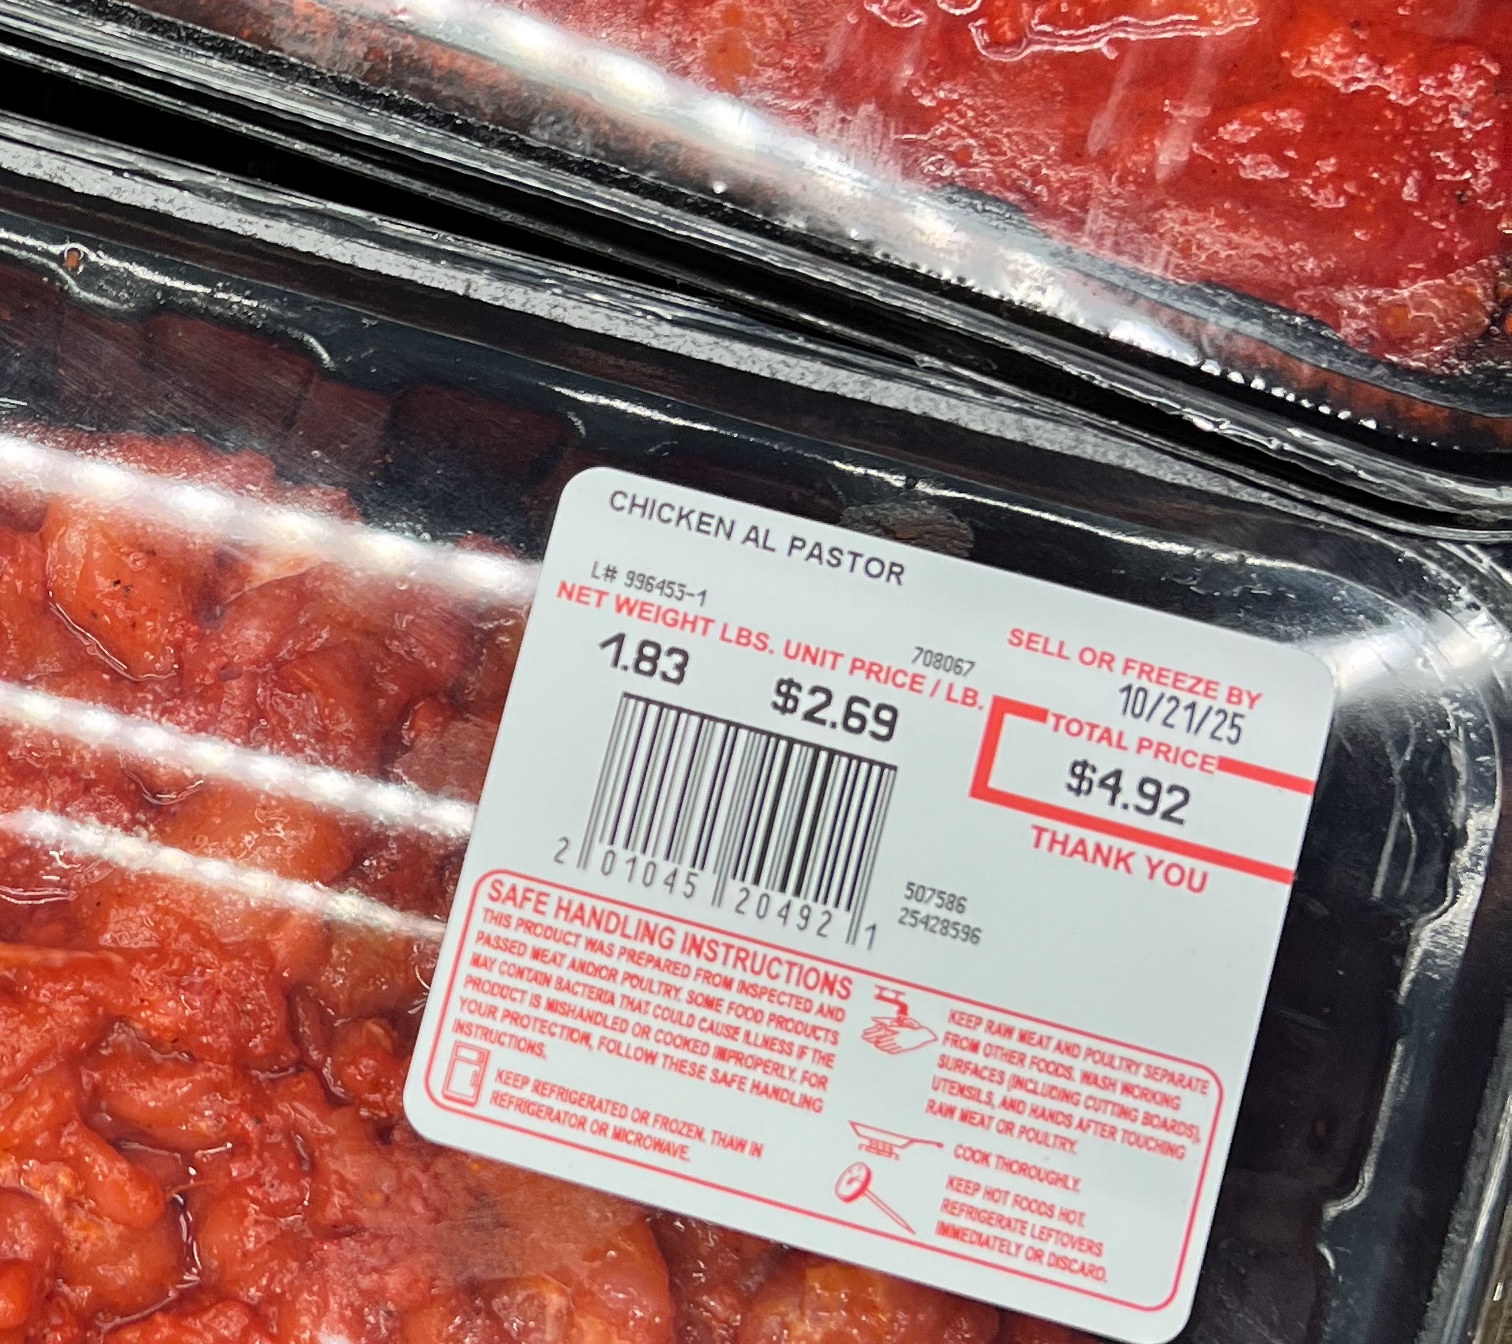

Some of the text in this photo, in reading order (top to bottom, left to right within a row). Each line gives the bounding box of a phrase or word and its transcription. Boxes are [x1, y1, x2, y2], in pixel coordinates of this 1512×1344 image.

[609, 489, 905, 586] CHICKEN AL PASTOR
[556, 580, 609, 608] NET
[614, 594, 715, 636] WEIGHT
[719, 622, 774, 654] LBS.
[782, 638, 844, 671] UNIT
[848, 656, 926, 694] PRICE
[944, 682, 983, 710] LB.
[599, 632, 689, 685] 1.83
[911, 645, 975, 677] 708067
[1007, 627, 1262, 710] SELL OR FREEZE BY
[770, 677, 898, 742] $2.69
[1118, 682, 1245, 745] 10/21/25
[1050, 712, 1218, 774] TOTAL PRICE
[1065, 758, 1190, 825] $4.92
[1031, 824, 1208, 893] THANK YOU
[897, 906, 982, 945] 25428596
[903, 880, 968, 914] 507586
[483, 907, 845, 1022] THIS PRODUCT WAS PREPARED FROM INSPECTED AND
[487, 878, 853, 1000] SAFE HANDLING INSTRUCTIONS
[451, 1018, 546, 1059] INSTRUCTIONS.
[460, 997, 823, 1113] YOUR PROTECTION, FOLLOW THESE SAFE HANDLING
[489, 1090, 694, 1163] REFRIGERATOR OR MICROWAVE.
[494, 1069, 763, 1158] KEEP REFRIGERATED OR FROZEN. THAW IN
[953, 1143, 1085, 1194] COOK THOROUGHLY.
[940, 1197, 1103, 1257] REFRIGERATE LEFTOVERS
